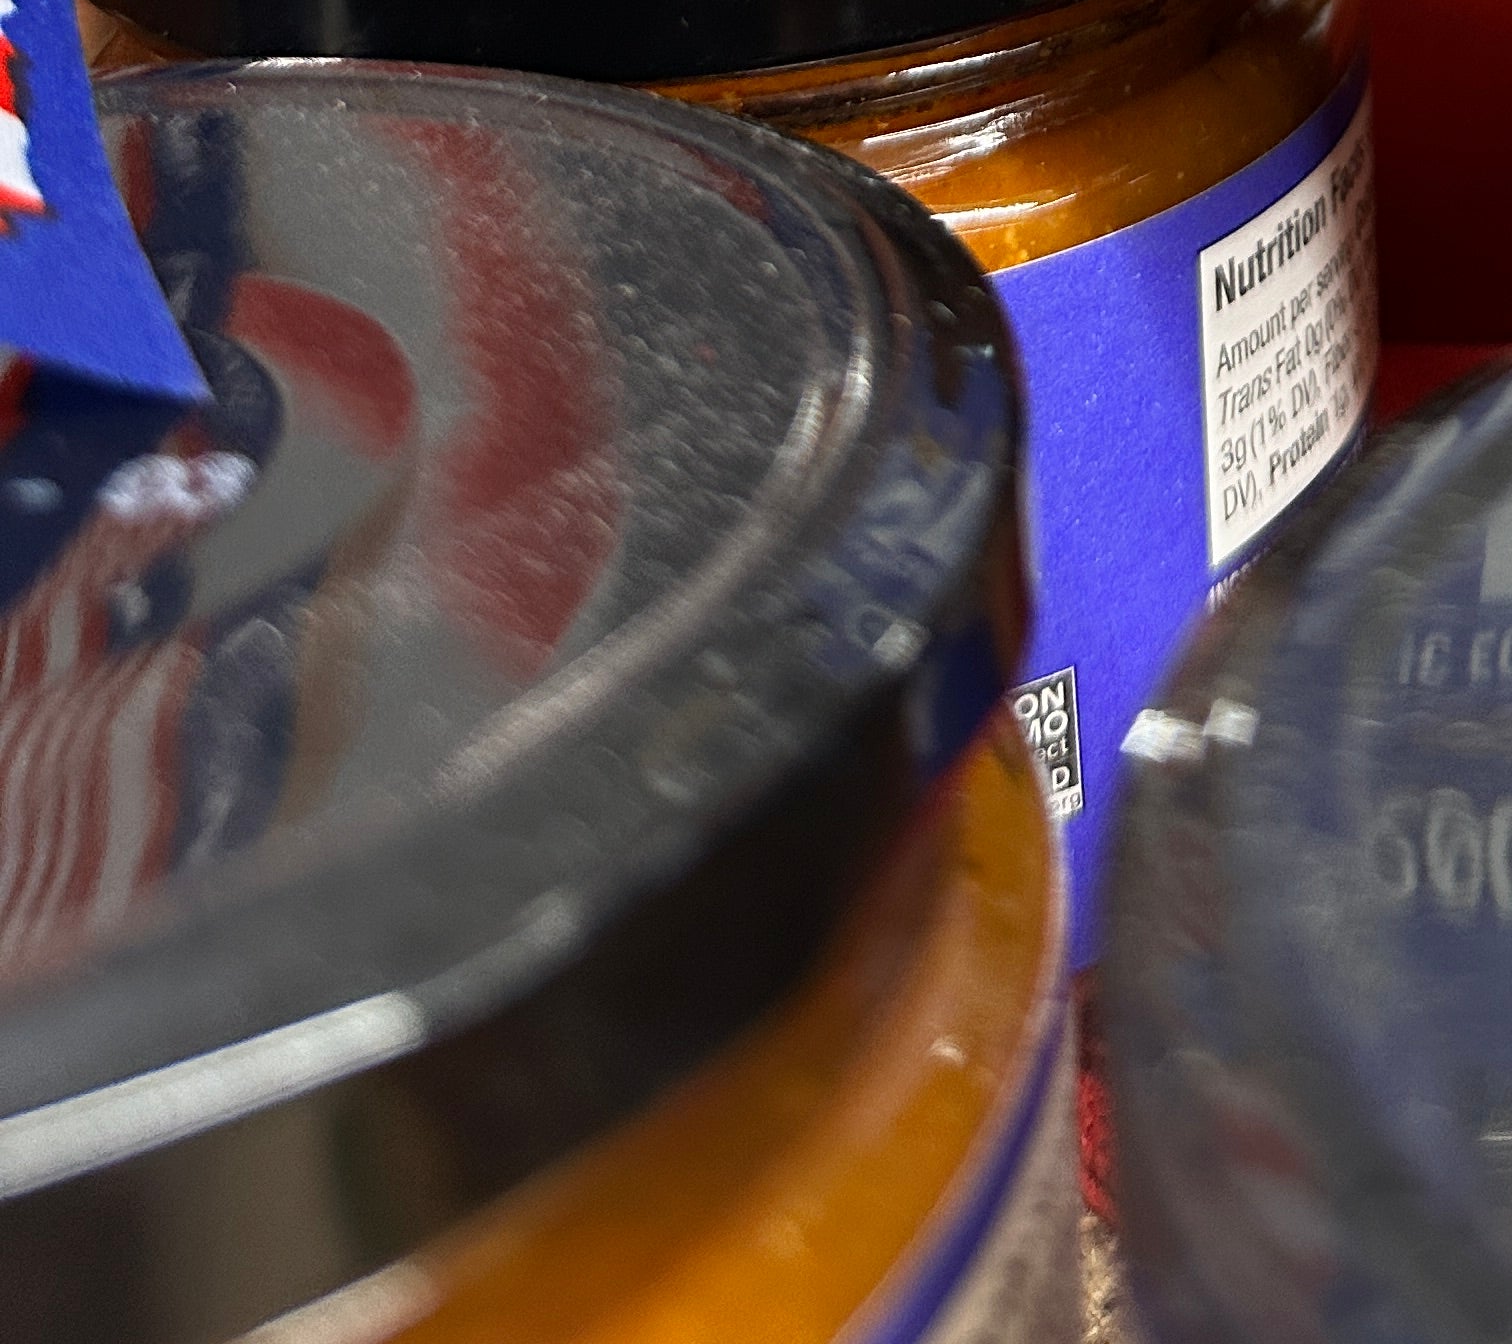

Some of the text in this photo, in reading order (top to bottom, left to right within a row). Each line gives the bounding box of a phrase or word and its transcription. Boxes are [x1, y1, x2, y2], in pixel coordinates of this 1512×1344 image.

[1214, 192, 1327, 312] Nutrition
[1217, 301, 1286, 379] Amount
[1291, 287, 1312, 327] per
[1219, 364, 1272, 427] Trans
[1275, 342, 1301, 384] Fat
[1221, 432, 1247, 475] 3g
[1224, 468, 1263, 522] DV),
[1269, 406, 1329, 487] Protein
[1014, 681, 1065, 719] ON
